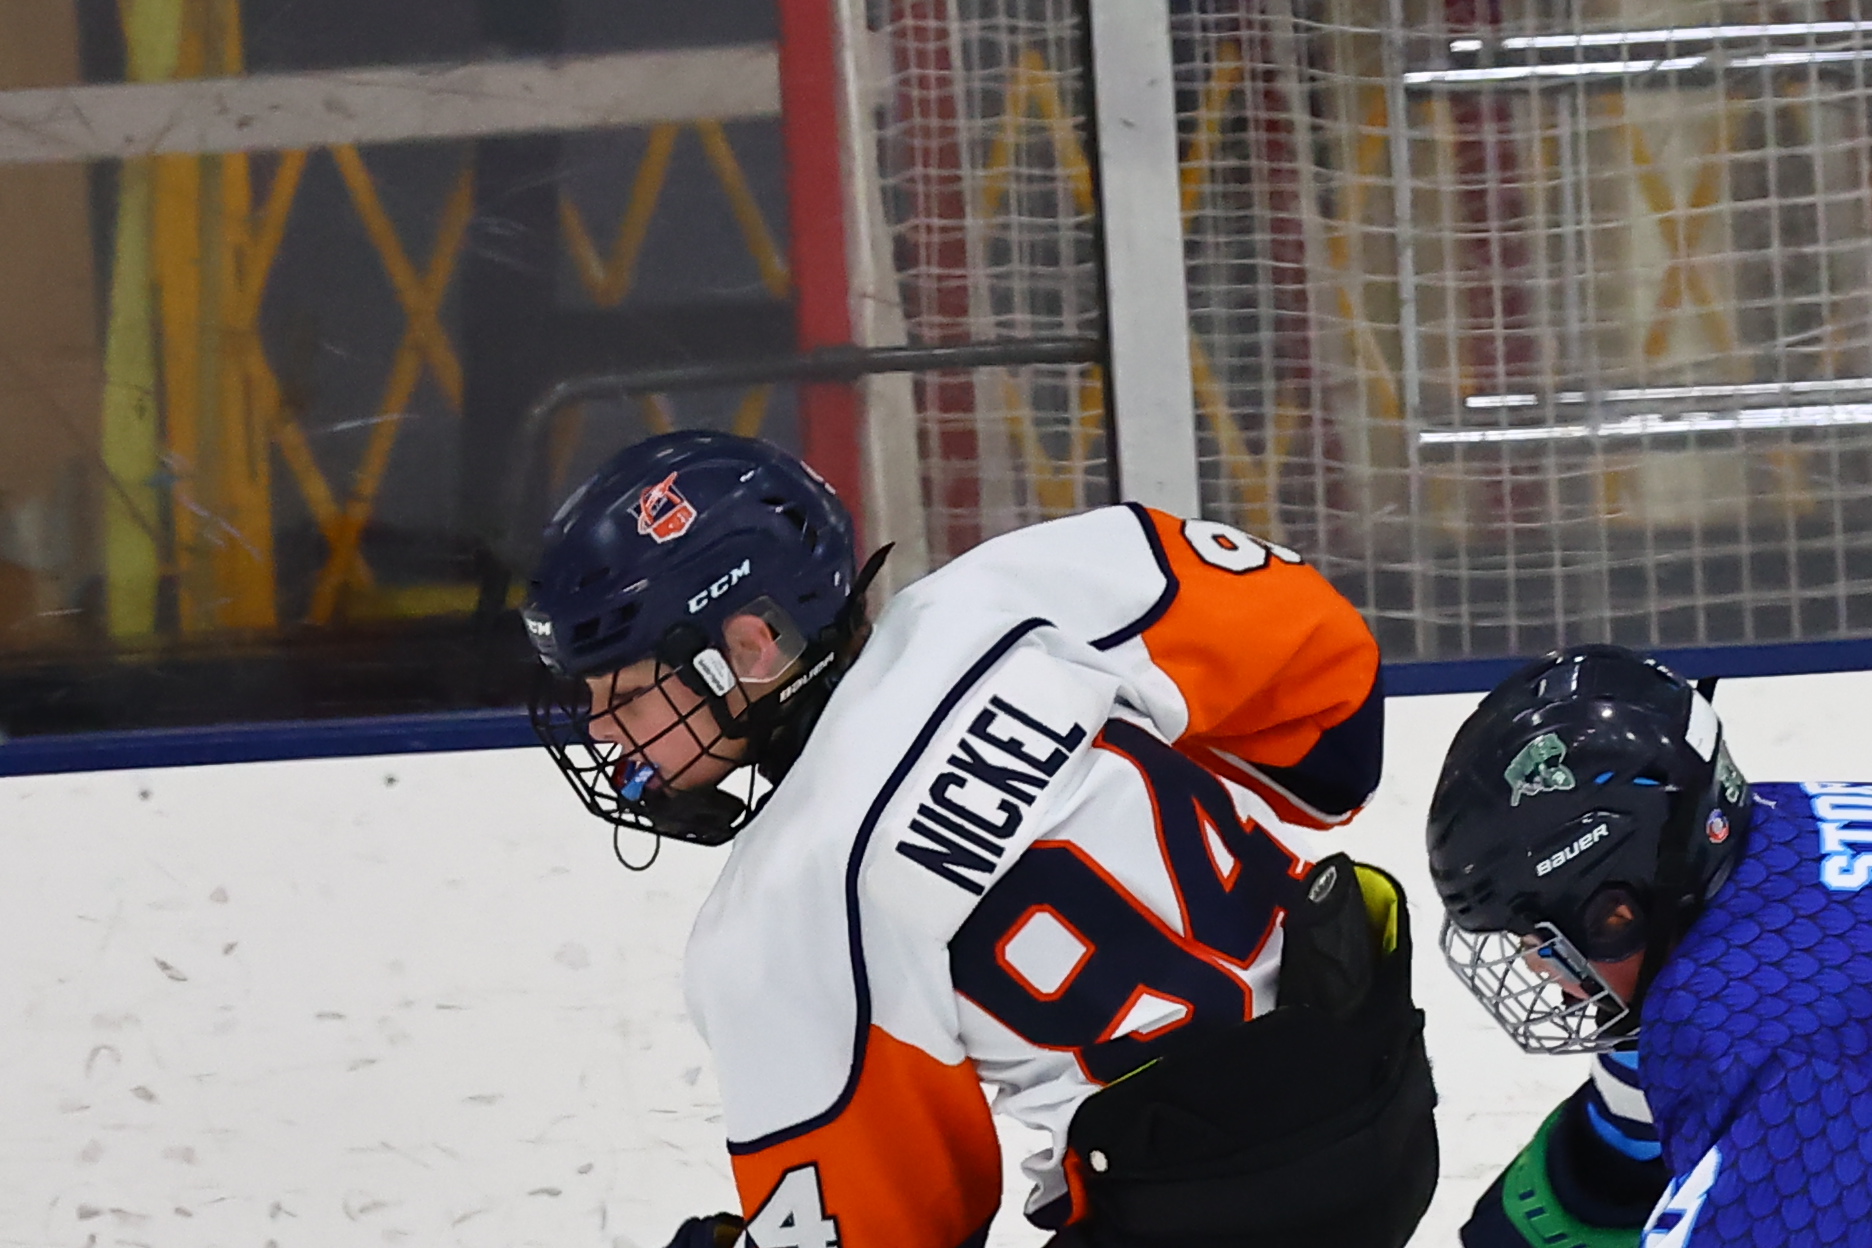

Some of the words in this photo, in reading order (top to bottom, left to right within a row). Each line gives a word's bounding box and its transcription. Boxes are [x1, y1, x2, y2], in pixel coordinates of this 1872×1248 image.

[688, 559, 751, 613] CCM
[895, 694, 1087, 896] NICKEL
[1536, 823, 1609, 877] BAUER
[947, 718, 1316, 1090] 94
